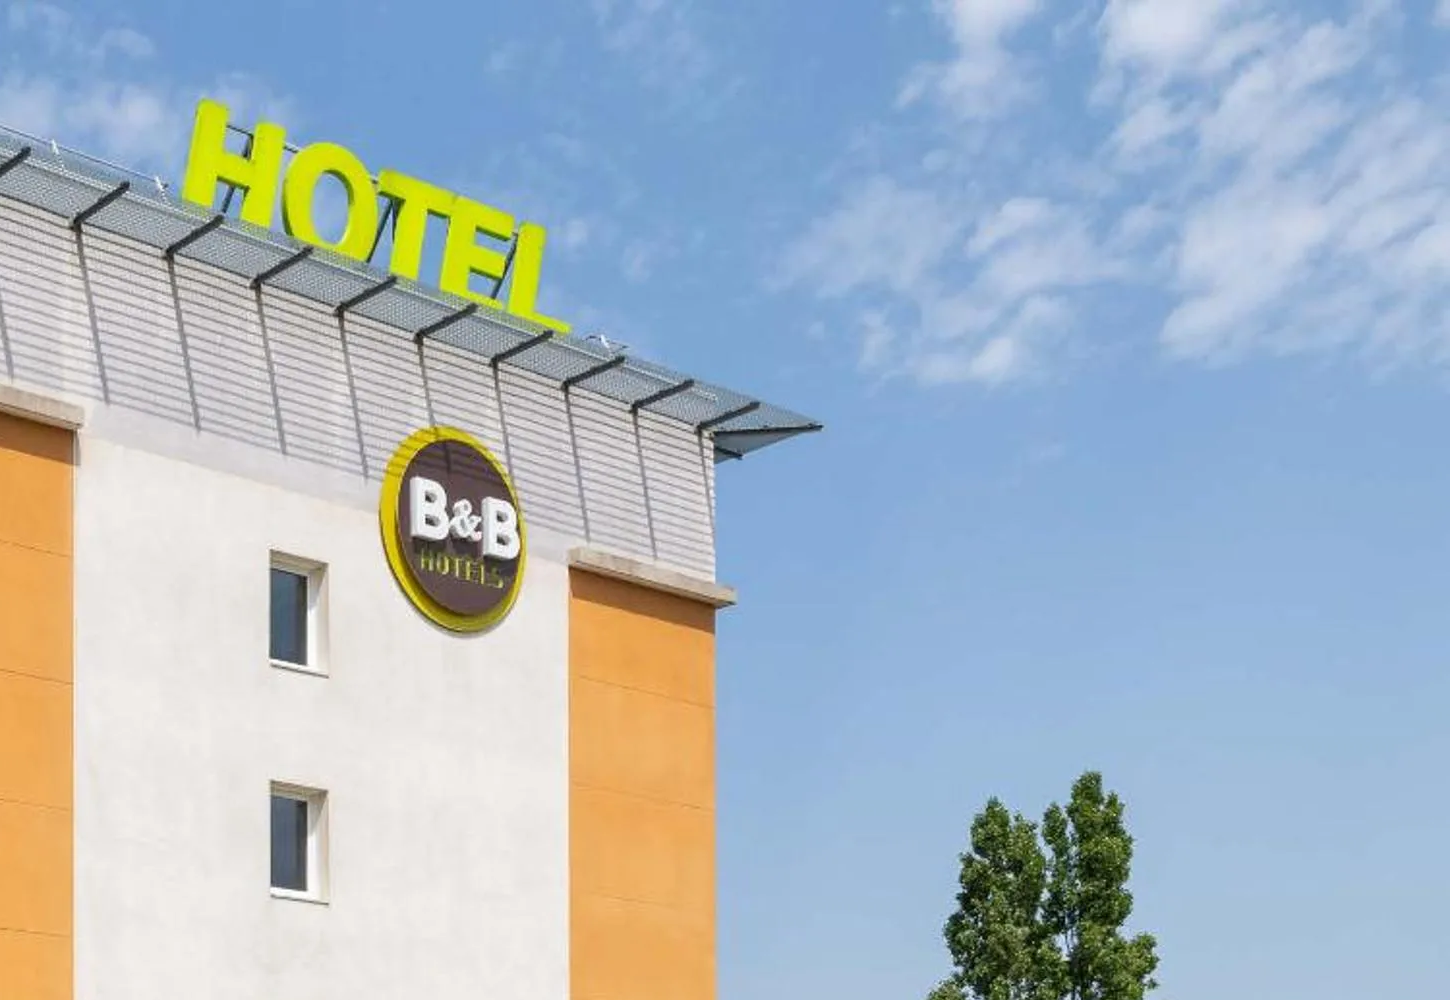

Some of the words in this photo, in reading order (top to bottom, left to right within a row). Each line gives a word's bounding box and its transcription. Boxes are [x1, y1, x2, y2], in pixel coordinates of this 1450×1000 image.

[182, 98, 571, 334] HOTEL
[410, 476, 520, 560] B&B
[420, 550, 504, 589] HOTELS
